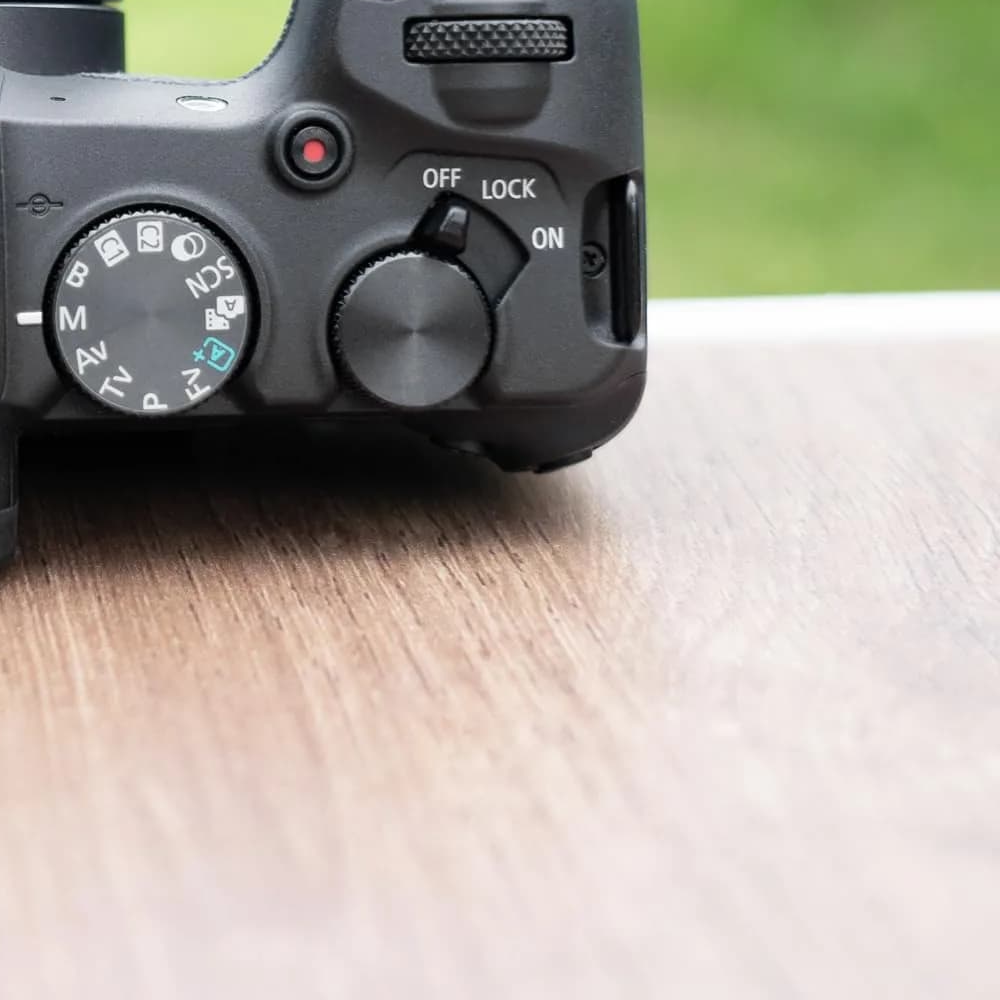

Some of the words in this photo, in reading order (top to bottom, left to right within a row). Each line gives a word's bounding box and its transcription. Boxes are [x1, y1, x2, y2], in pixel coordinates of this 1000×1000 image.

[422, 167, 462, 188] OFF
[481, 177, 537, 200] LOCK
[531, 226, 565, 249] ON
[65, 260, 89, 289] B
[184, 255, 235, 299] SCN
[59, 305, 87, 331] M
[75, 340, 109, 375] Av
[99, 365, 133, 398] Tv
[181, 367, 211, 401] Fv
[143, 392, 168, 411] P
